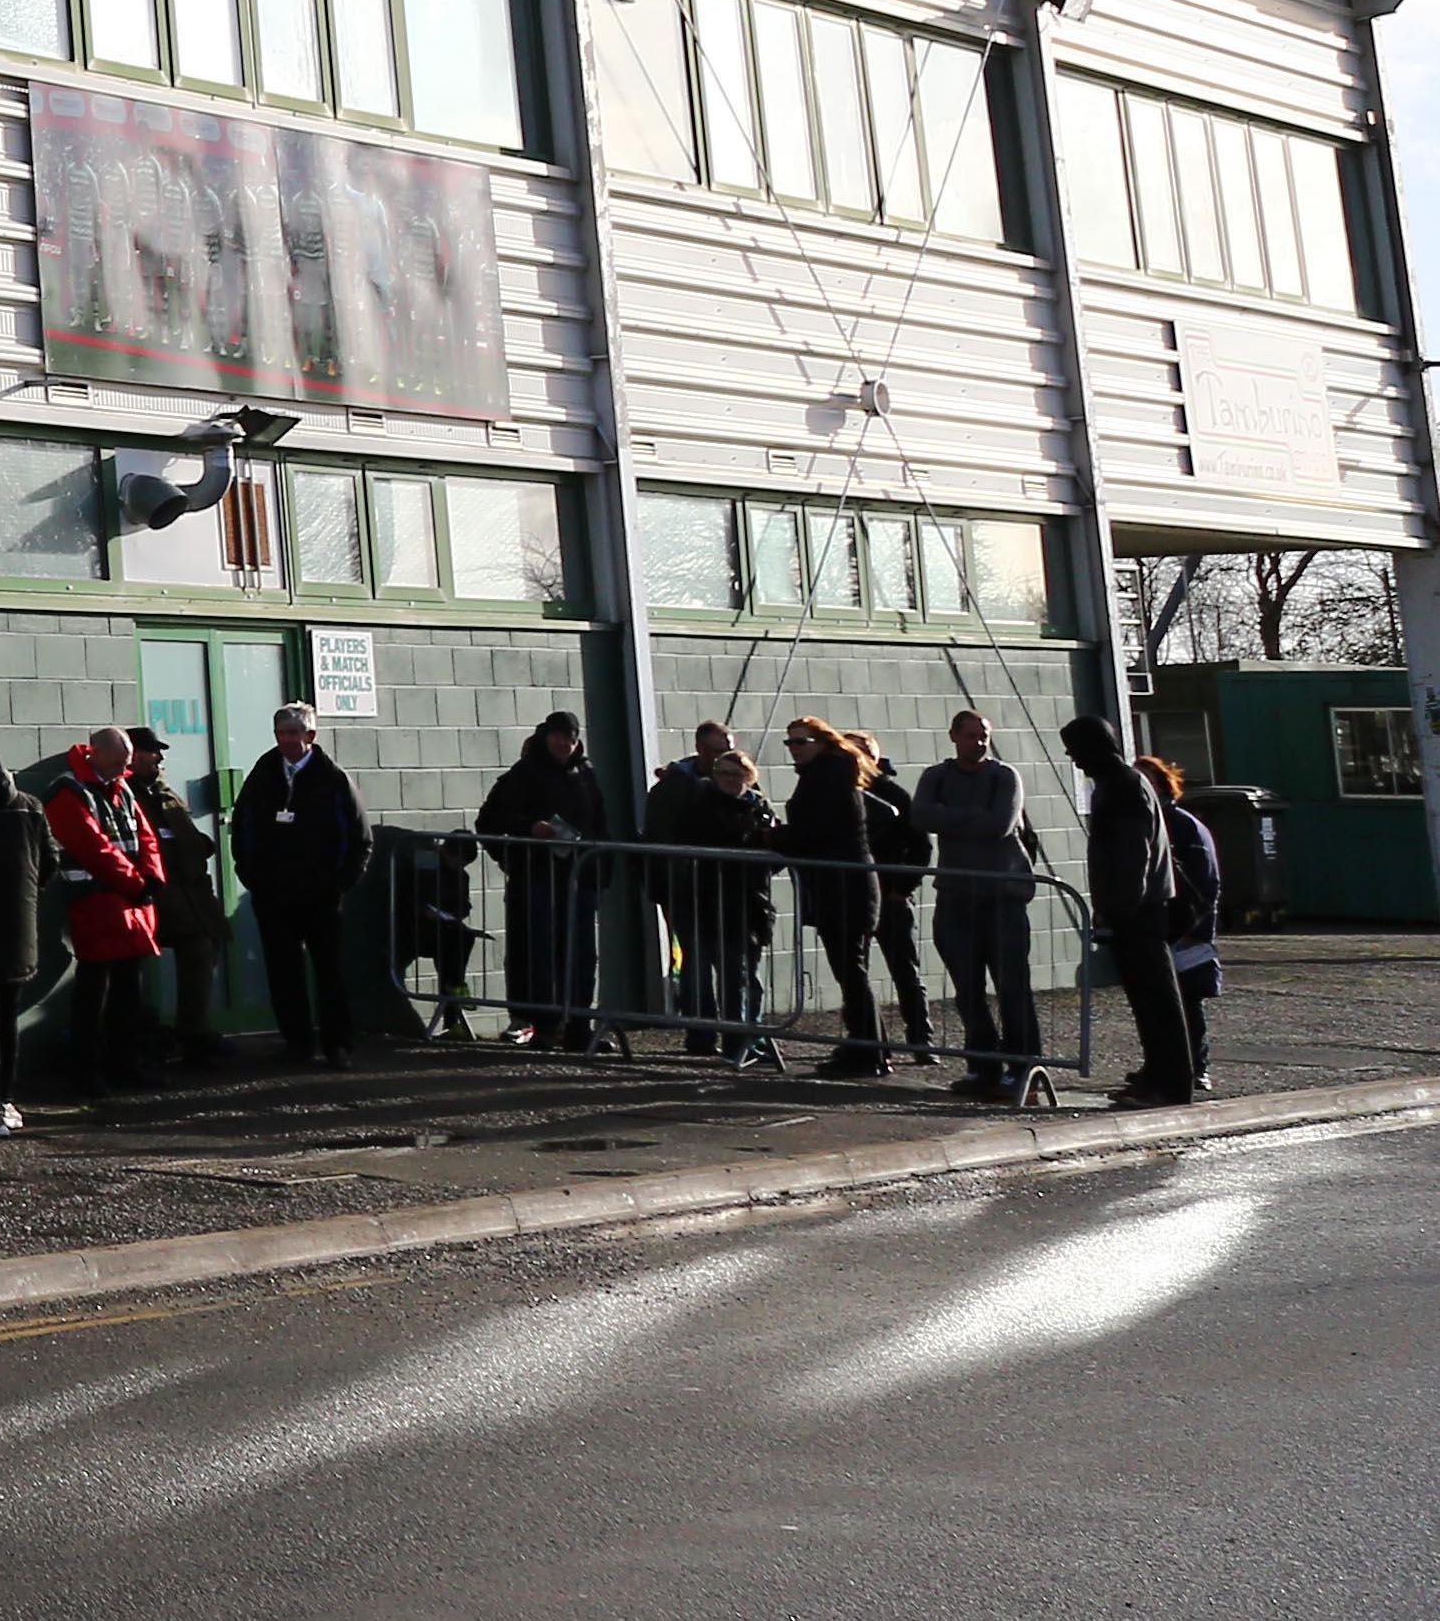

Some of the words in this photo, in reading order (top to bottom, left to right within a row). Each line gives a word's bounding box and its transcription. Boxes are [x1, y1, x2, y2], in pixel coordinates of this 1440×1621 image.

[1195, 370, 1323, 440] Tamburino
[320, 637, 367, 654] PLAYERS
[321, 655, 330, 672] &
[332, 656, 369, 673] MATCH
[318, 674, 373, 692] OFFICIALS
[336, 694, 358, 712] ONLY
[147, 698, 208, 734] PULL
